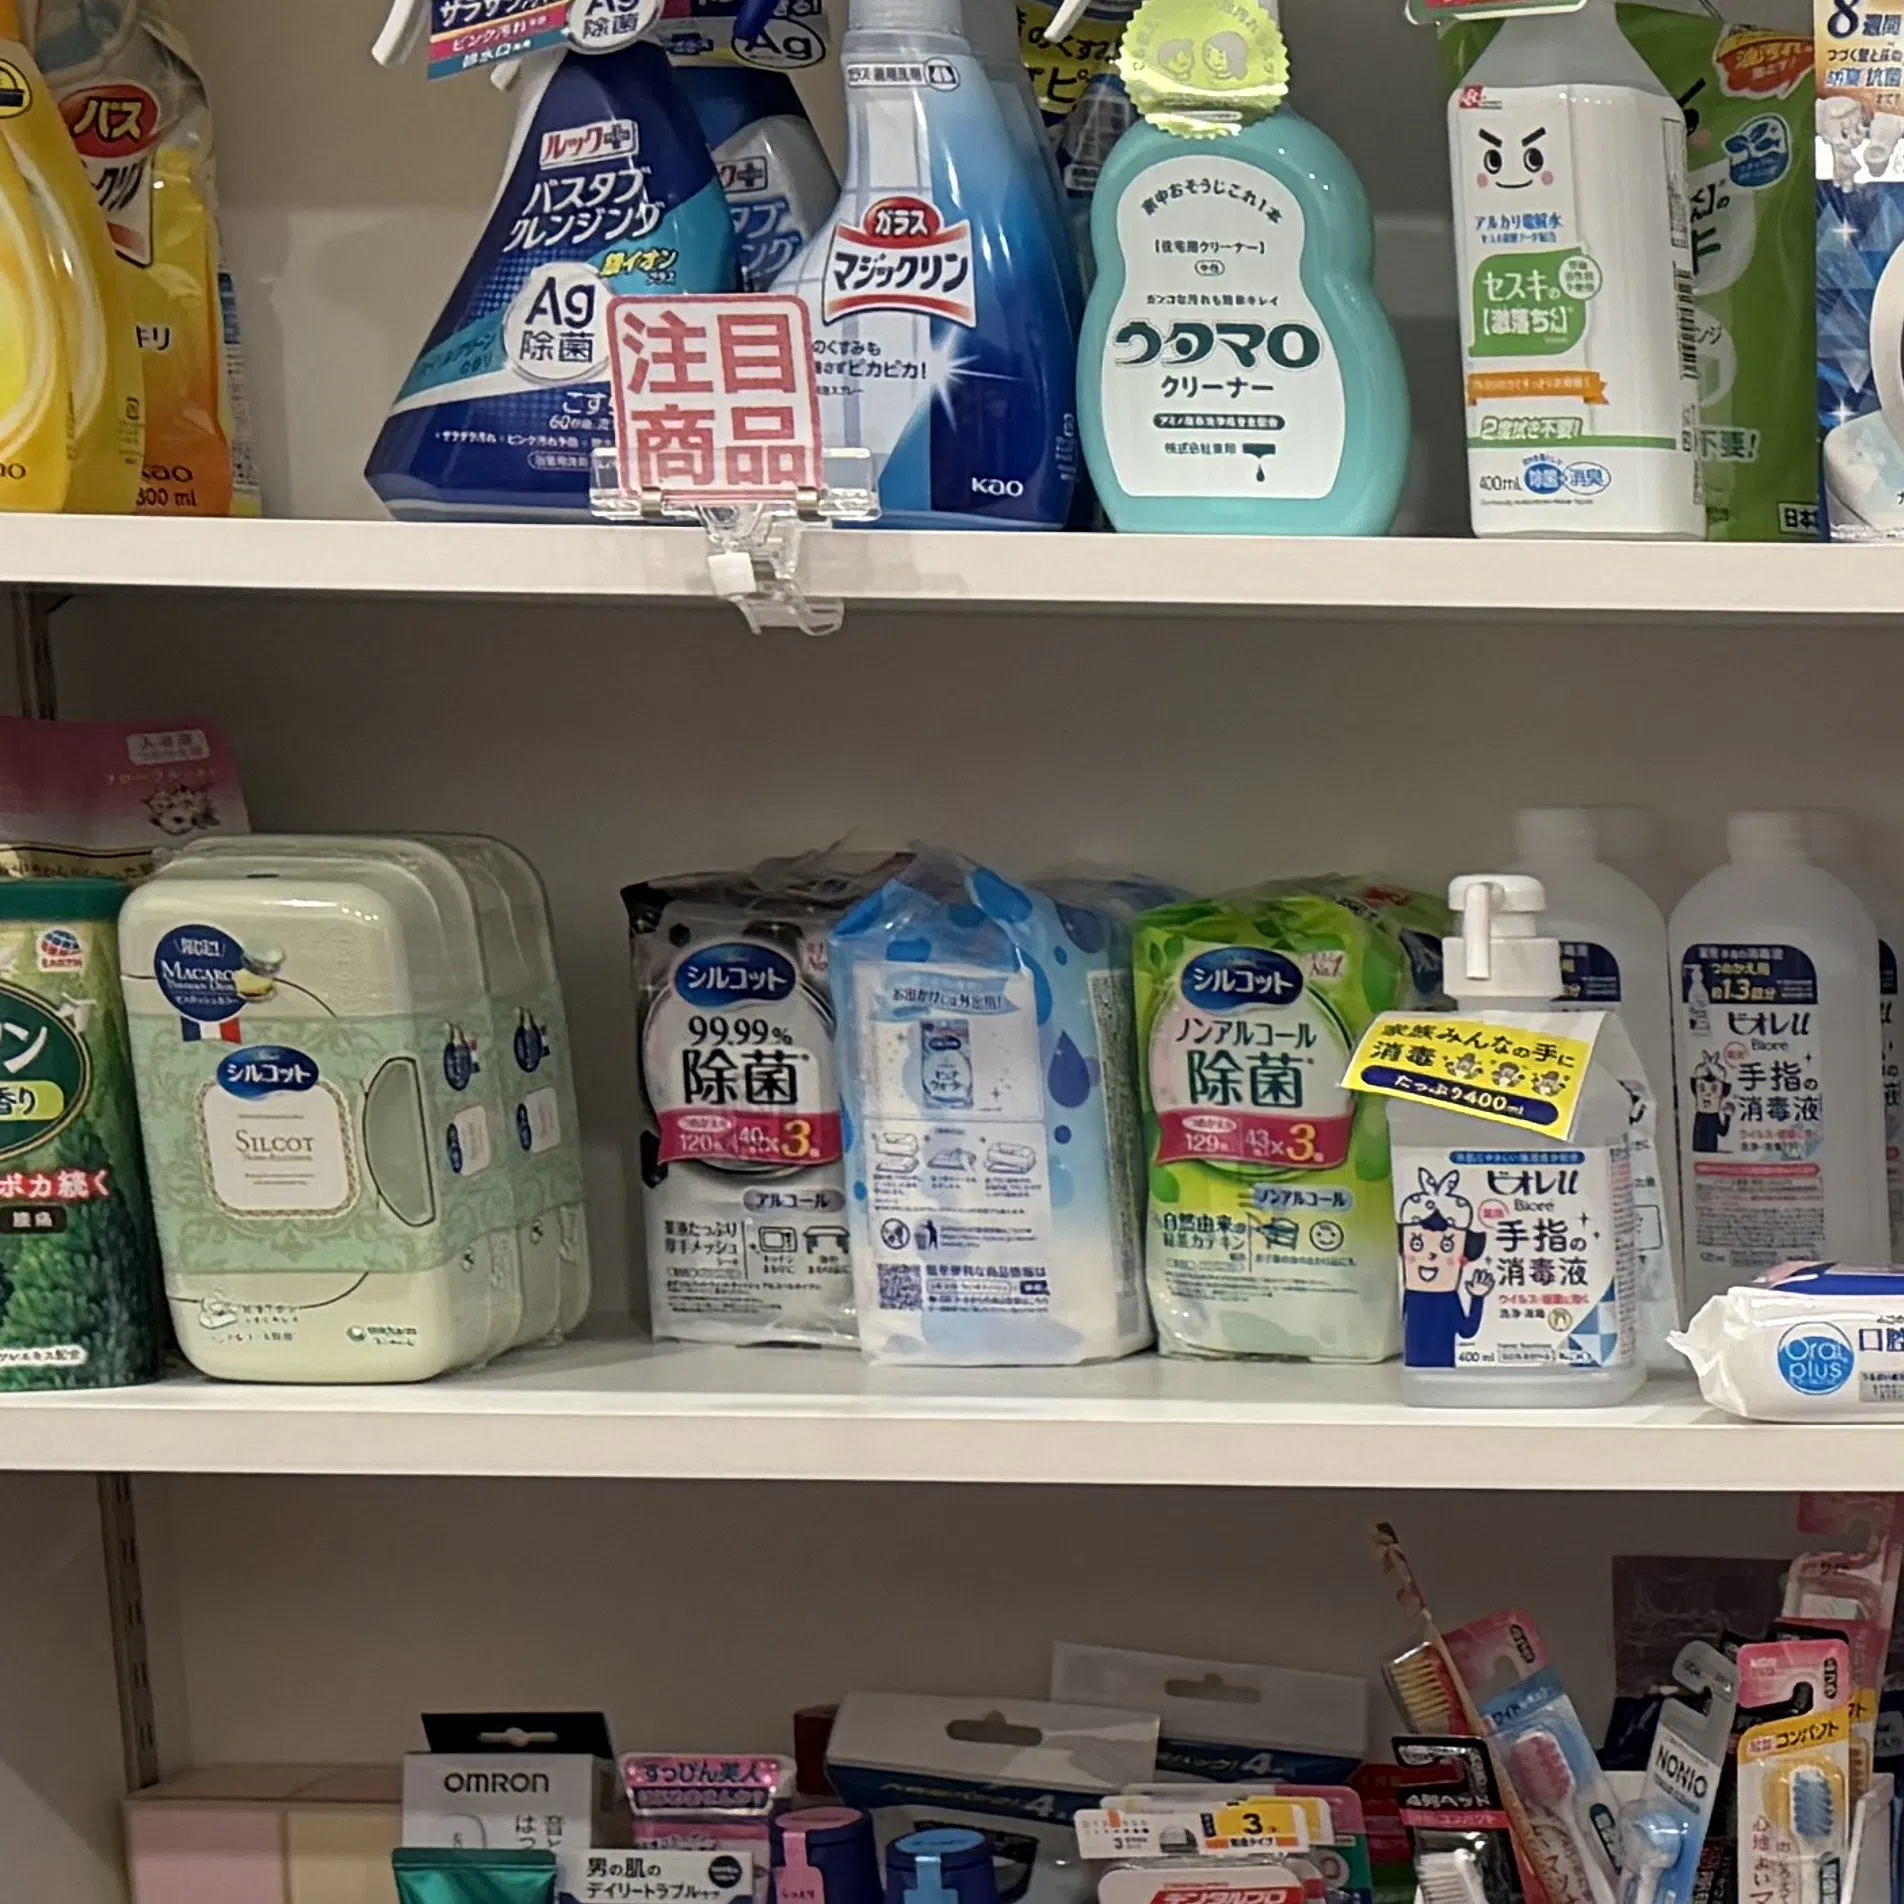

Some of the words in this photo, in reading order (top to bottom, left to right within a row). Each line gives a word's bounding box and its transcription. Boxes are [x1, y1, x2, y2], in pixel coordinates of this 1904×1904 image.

[524, 168, 652, 212] バスタブ
[503, 203, 665, 252] クレンジング
[832, 251, 969, 291] マジックリン
[529, 276, 594, 326] Ag
[520, 329, 594, 362] 除菌
[624, 313, 792, 394] 注目
[1114, 321, 1320, 370] ウタマロ
[1161, 377, 1274, 398] クリーナー
[633, 408, 796, 486] 商品
[686, 966, 788, 992] シルコット
[1192, 967, 1296, 994] シルコット
[1175, 1019, 1318, 1050] ノンアルコール
[226, 1062, 311, 1083] シルコット
[682, 1050, 798, 1105] 除菌
[1189, 1053, 1306, 1108] 除菌
[1738, 1062, 1819, 1090] 手指の
[1496, 1220, 1587, 1253] 手指の
[1498, 1260, 1589, 1287] 消毒液
